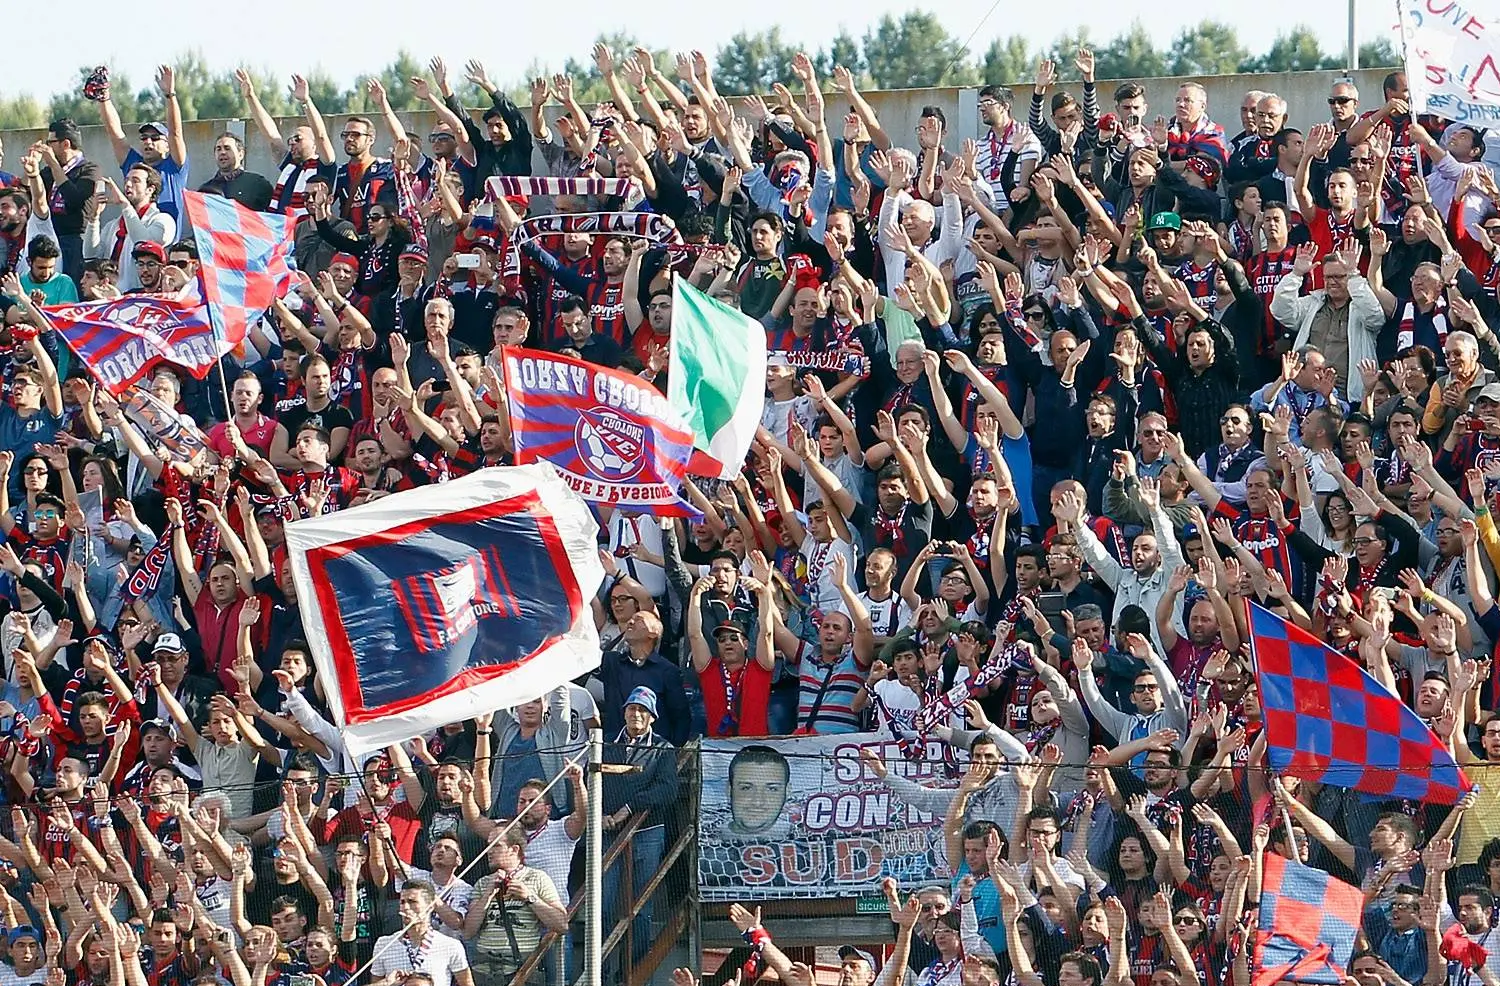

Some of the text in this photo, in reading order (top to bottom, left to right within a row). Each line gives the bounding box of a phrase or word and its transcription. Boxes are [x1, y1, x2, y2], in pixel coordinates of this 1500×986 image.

[803, 791, 892, 833] CON
[740, 837, 883, 886] SUD
[858, 901, 891, 913] SICURE
